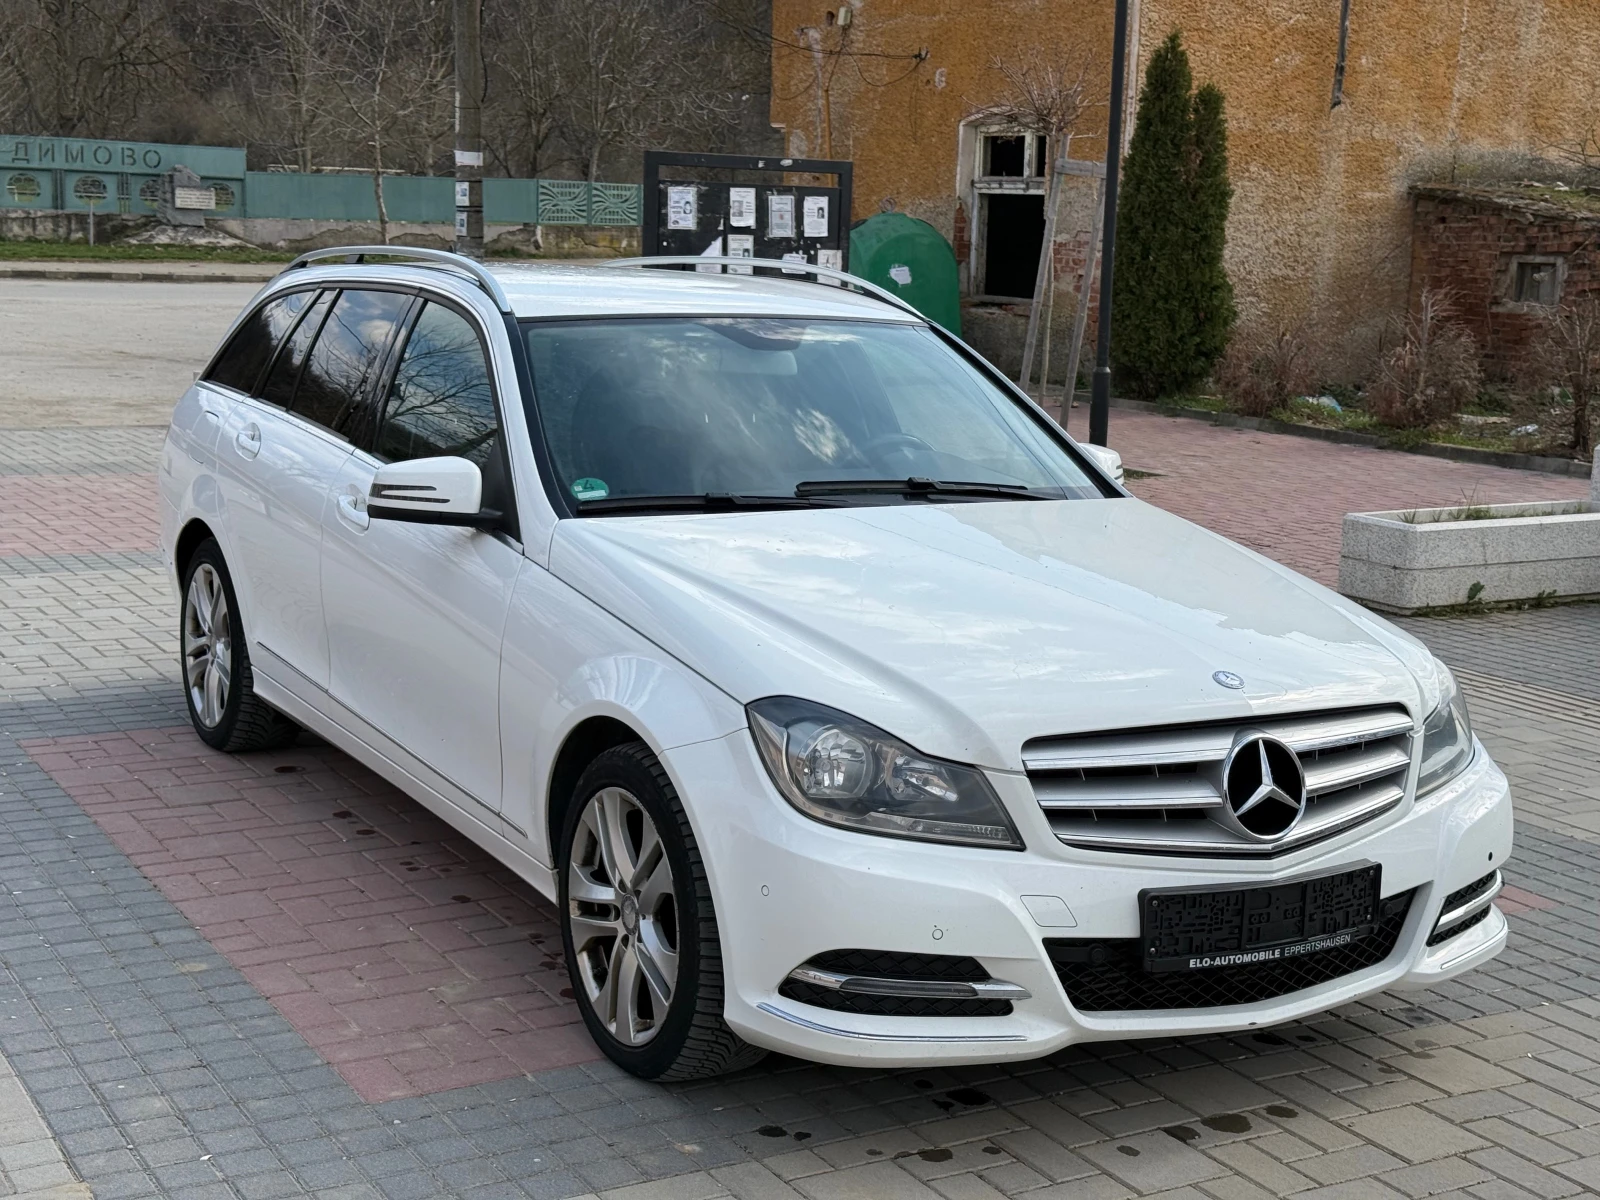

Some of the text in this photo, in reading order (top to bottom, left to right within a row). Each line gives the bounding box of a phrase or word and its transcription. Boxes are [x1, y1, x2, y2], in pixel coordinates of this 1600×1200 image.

[11, 141, 162, 169] ДИМОВО
[583, 479, 595, 490] 4
[1189, 933, 1351, 968] ELO-AUTOMOBILE EPPERTSHAUSEN
